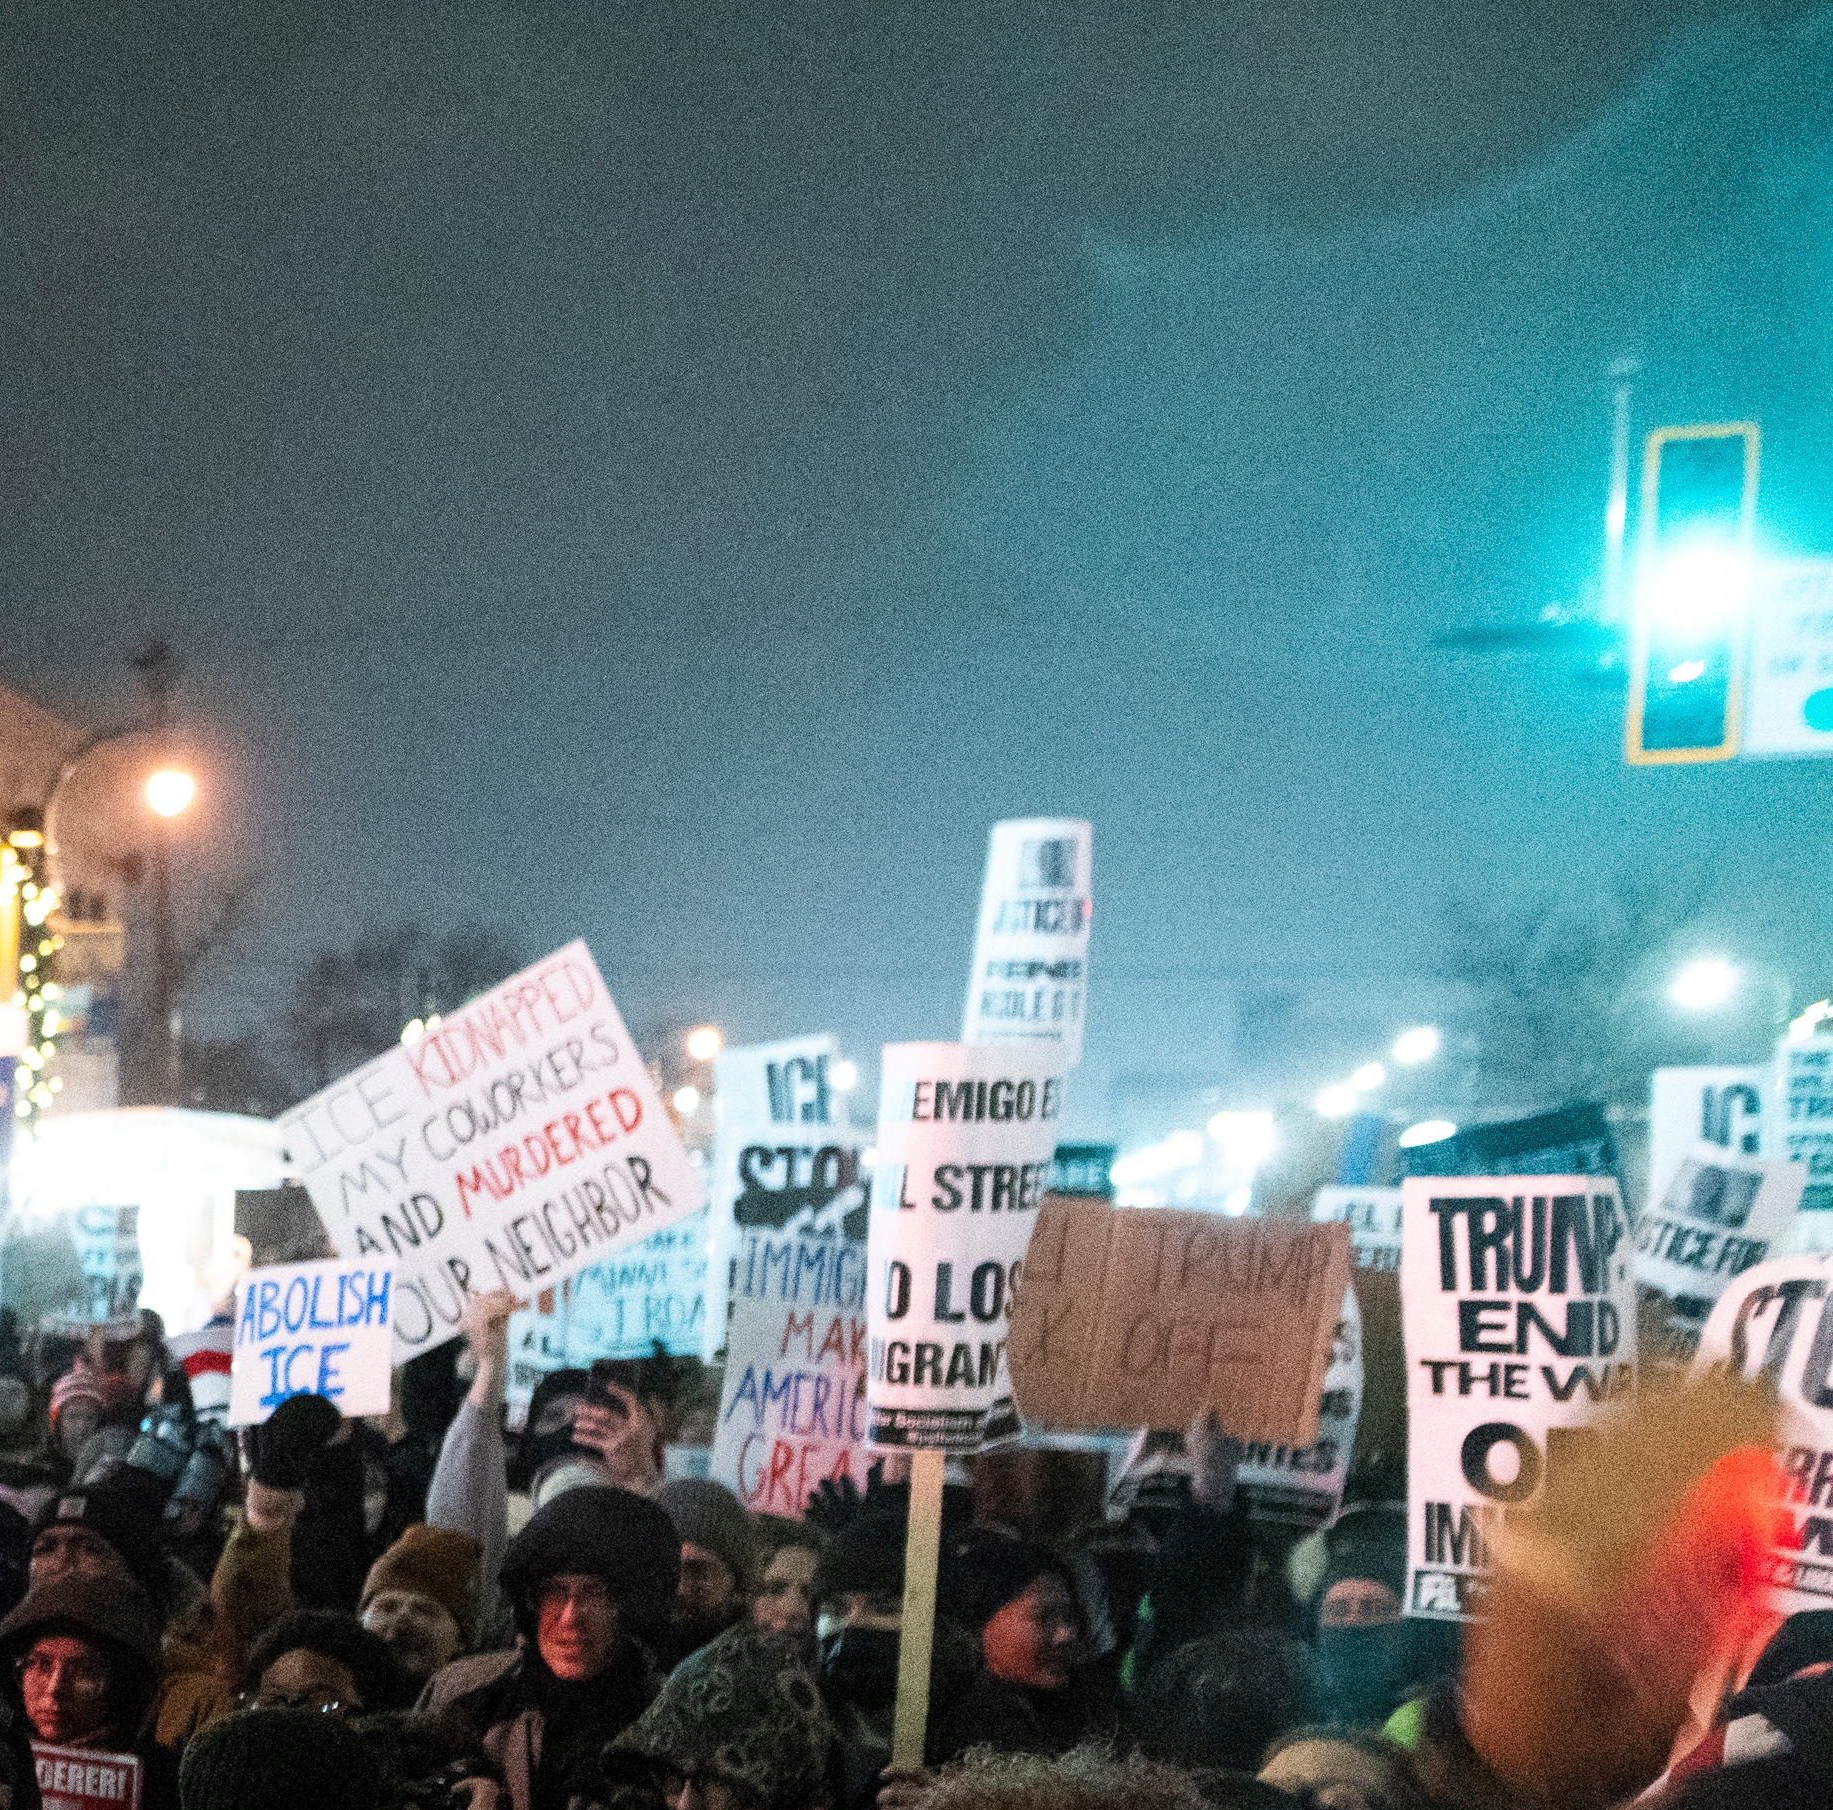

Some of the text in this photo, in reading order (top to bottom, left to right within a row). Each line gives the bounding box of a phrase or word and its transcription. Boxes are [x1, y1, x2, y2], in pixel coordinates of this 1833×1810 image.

[405, 960, 597, 1100] KIDNAPPED
[336, 1018, 621, 1216] MY COWORKERS
[355, 1086, 644, 1258] AND MURDERED
[484, 1154, 672, 1285] NEIGHBOR
[236, 1269, 393, 1346] ABOLISH
[1457, 1299, 1621, 1358] END
[258, 1341, 352, 1408] ICE
[1420, 1359, 1531, 1402] THE
